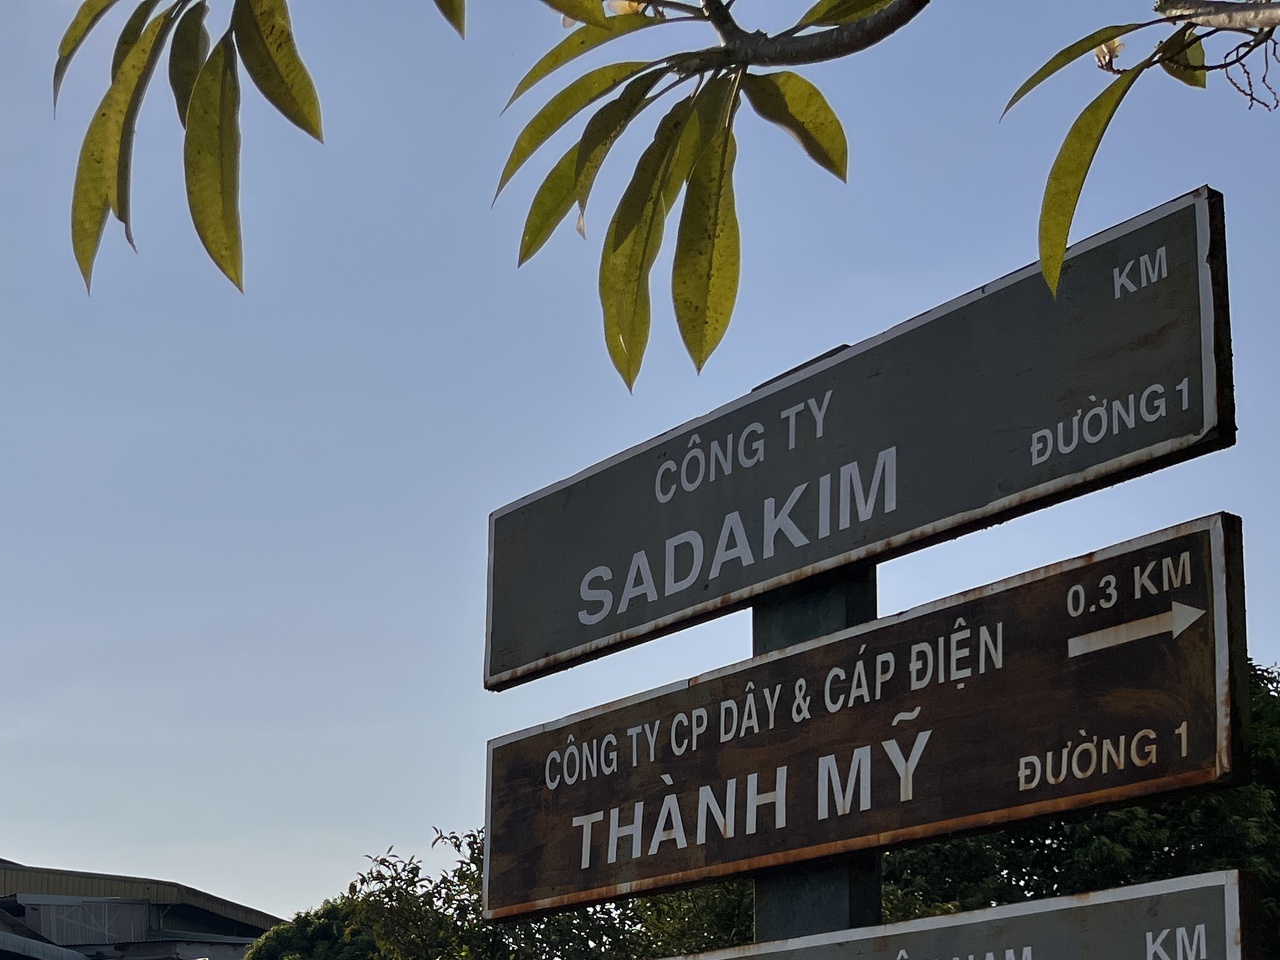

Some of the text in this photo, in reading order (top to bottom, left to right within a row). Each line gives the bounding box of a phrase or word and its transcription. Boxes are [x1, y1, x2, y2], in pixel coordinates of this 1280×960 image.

[1113, 246, 1168, 300] KM
[655, 389, 834, 504] CÔNG TY
[1031, 377, 1190, 466] ĐƯỜNG 1
[578, 446, 897, 625] SADAKIM
[1066, 551, 1192, 618] 0.3 KM
[545, 617, 1003, 790] CÔNG TY CP DÂY & CÁP ĐIỆN
[572, 706, 932, 869] THÀNH MỸ
[1018, 722, 1189, 791] ĐƯỜNG 1
